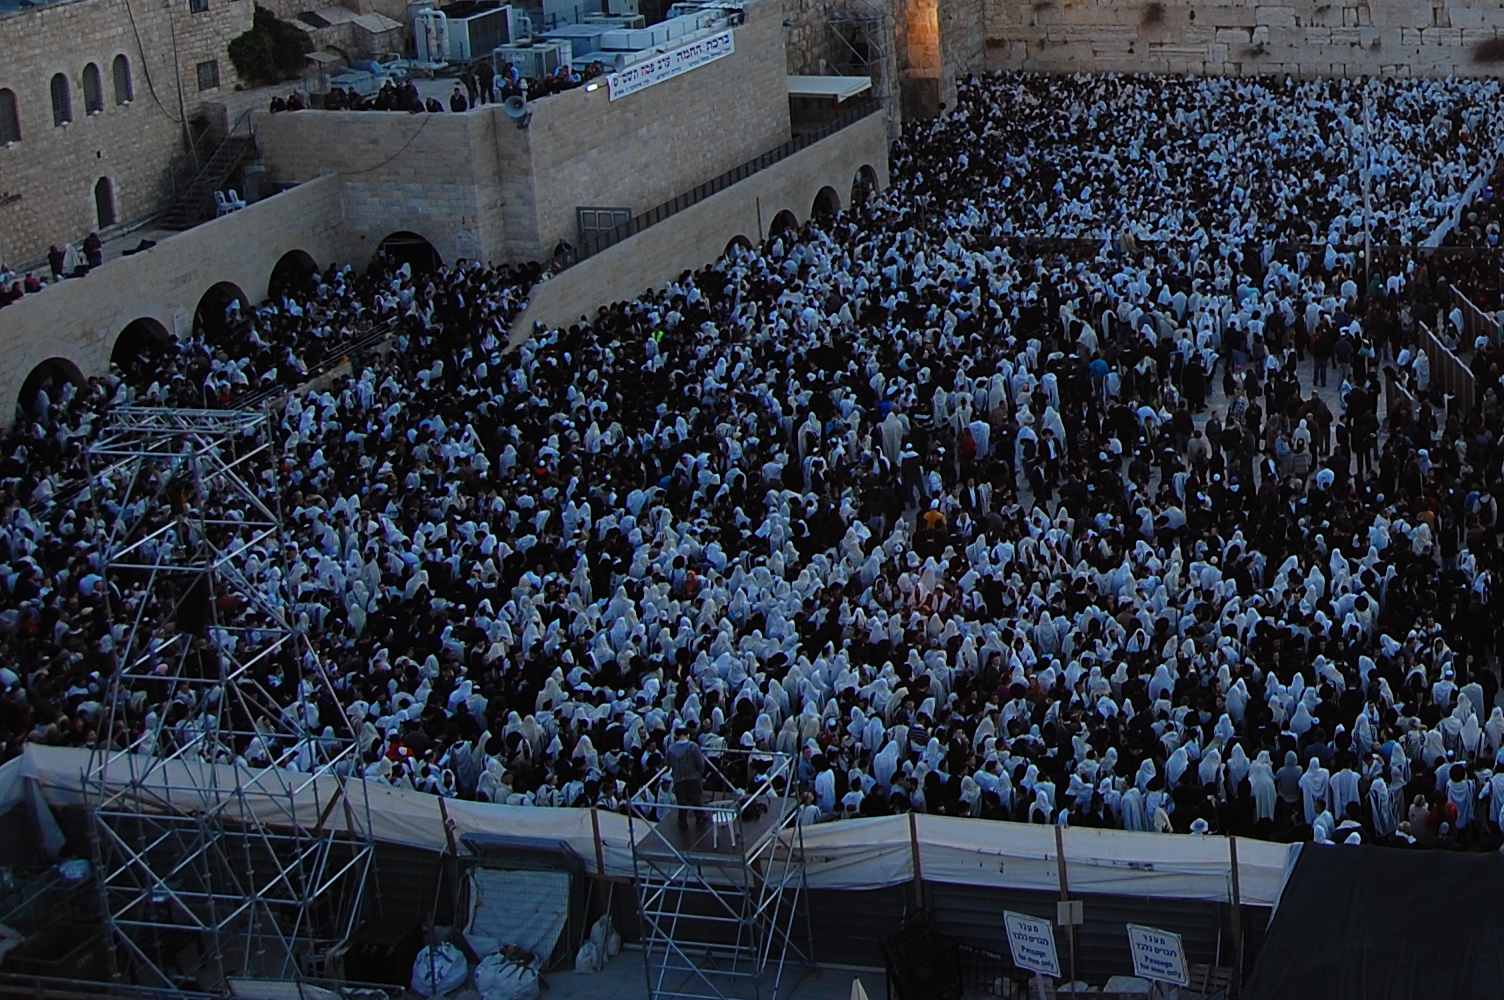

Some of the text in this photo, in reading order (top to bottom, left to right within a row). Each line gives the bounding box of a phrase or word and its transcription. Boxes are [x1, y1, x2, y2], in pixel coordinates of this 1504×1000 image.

[706, 34, 730, 51] ברכת
[676, 45, 702, 63] החמה
[640, 63, 655, 76] פסח
[657, 56, 670, 70] ערב
[1018, 922, 1039, 932] מעבר
[1012, 931, 1049, 946] לגברים בלבד
[1142, 934, 1166, 945] מעבר
[1021, 945, 1047, 958] Passage
[1136, 942, 1177, 957] לגברים בלבד
[1018, 952, 1054, 969] for men only
[1145, 955, 1173, 968] Passage
[1140, 962, 1181, 979] for men only
